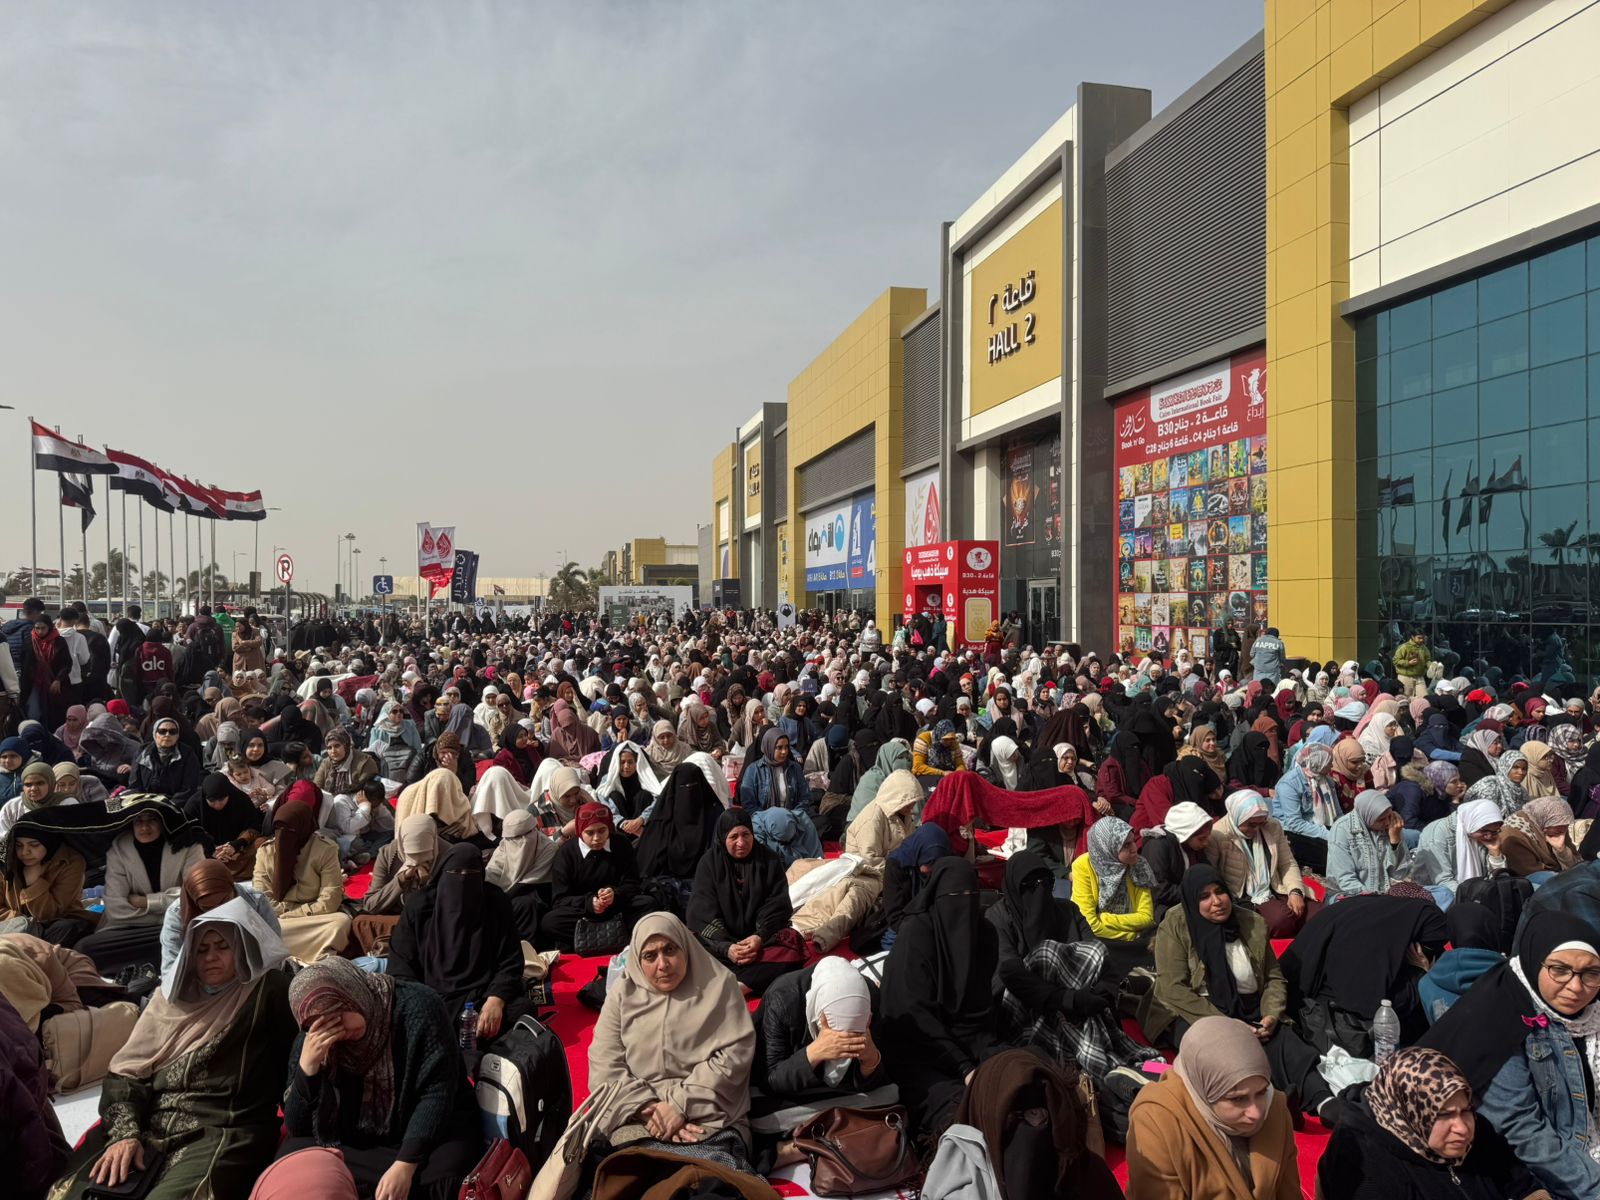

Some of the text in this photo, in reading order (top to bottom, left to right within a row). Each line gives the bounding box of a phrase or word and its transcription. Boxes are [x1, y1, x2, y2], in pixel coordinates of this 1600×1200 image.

[1001, 270, 1035, 311] قاعة
[987, 312, 1035, 364] HALL 2
[1174, 418, 1189, 435] جناح
[1195, 413, 1201, 425] 2
[1157, 422, 1174, 437] B30
[1203, 427, 1217, 443] جناح
[1222, 421, 1239, 435] قاعة
[1174, 435, 1188, 447] قاعة
